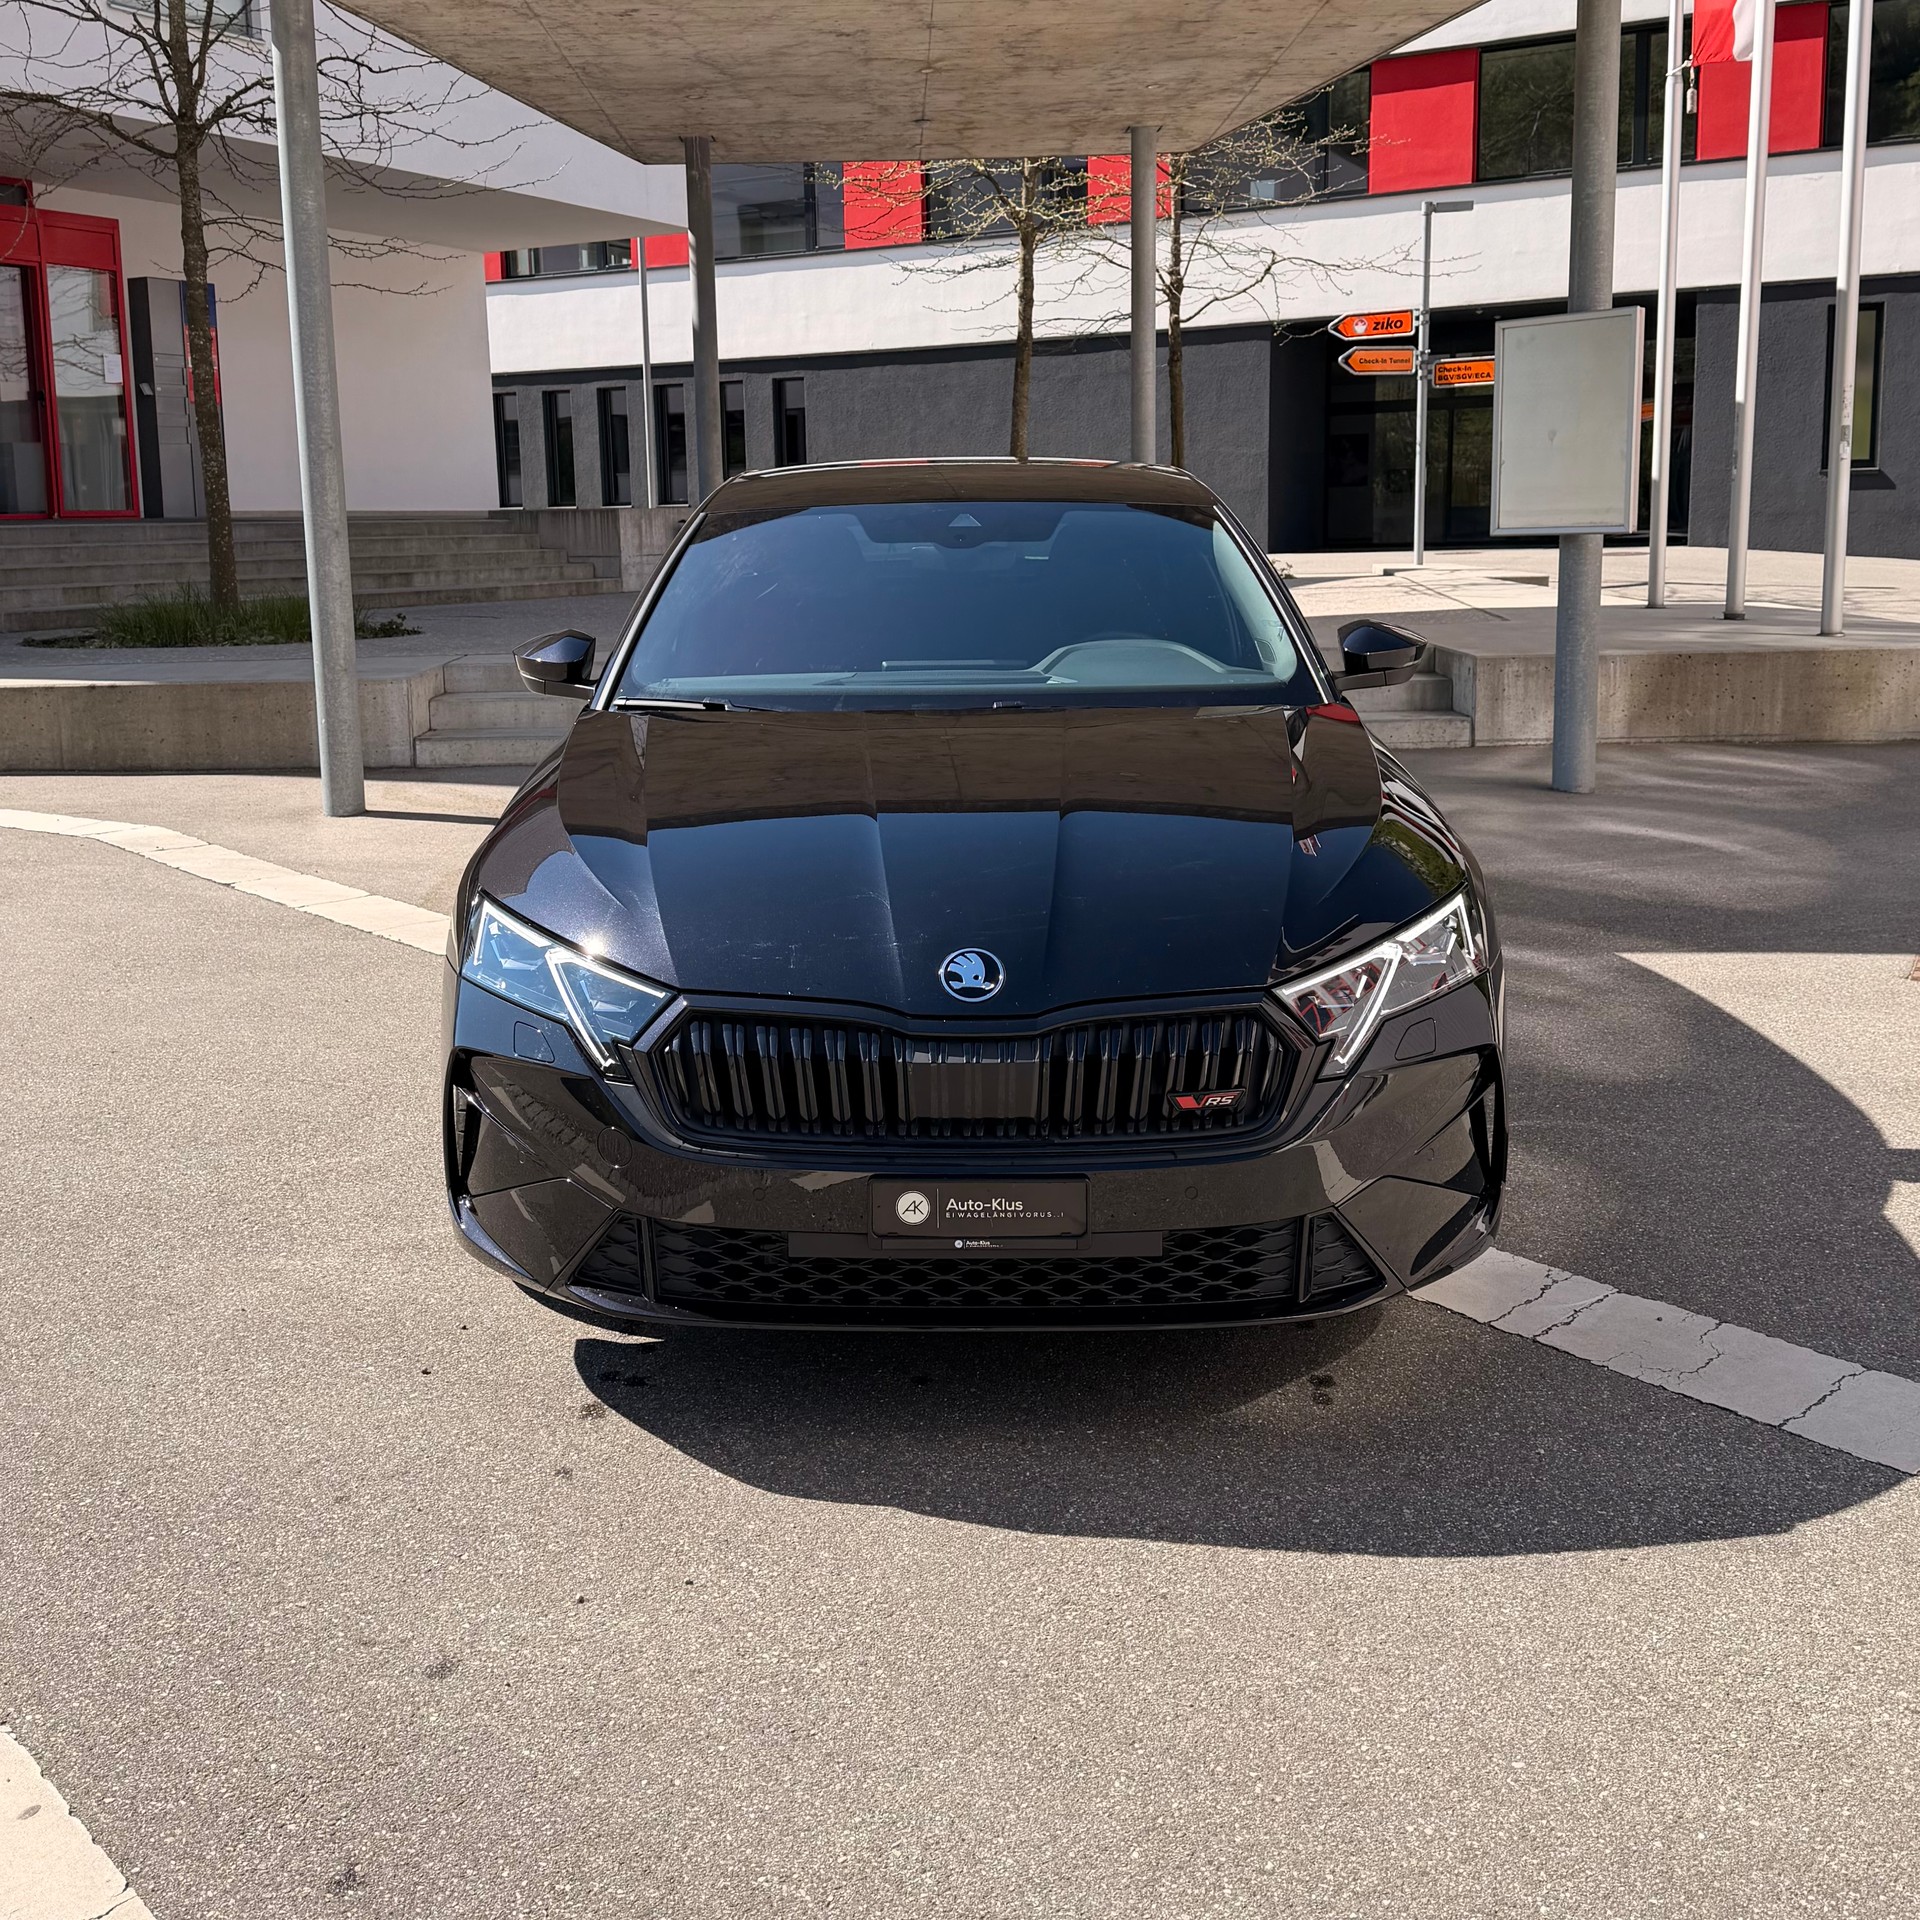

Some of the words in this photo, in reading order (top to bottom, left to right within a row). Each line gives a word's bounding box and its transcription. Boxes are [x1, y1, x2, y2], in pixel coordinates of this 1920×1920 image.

[1373, 317, 1403, 331] ziko
[1359, 357, 1387, 365] Check-In
[1389, 357, 1411, 365] Tunnel
[1438, 365, 1472, 373] Check-In
[902, 1200, 925, 1215] AK
[946, 1198, 1024, 1211] Auto-Klus
